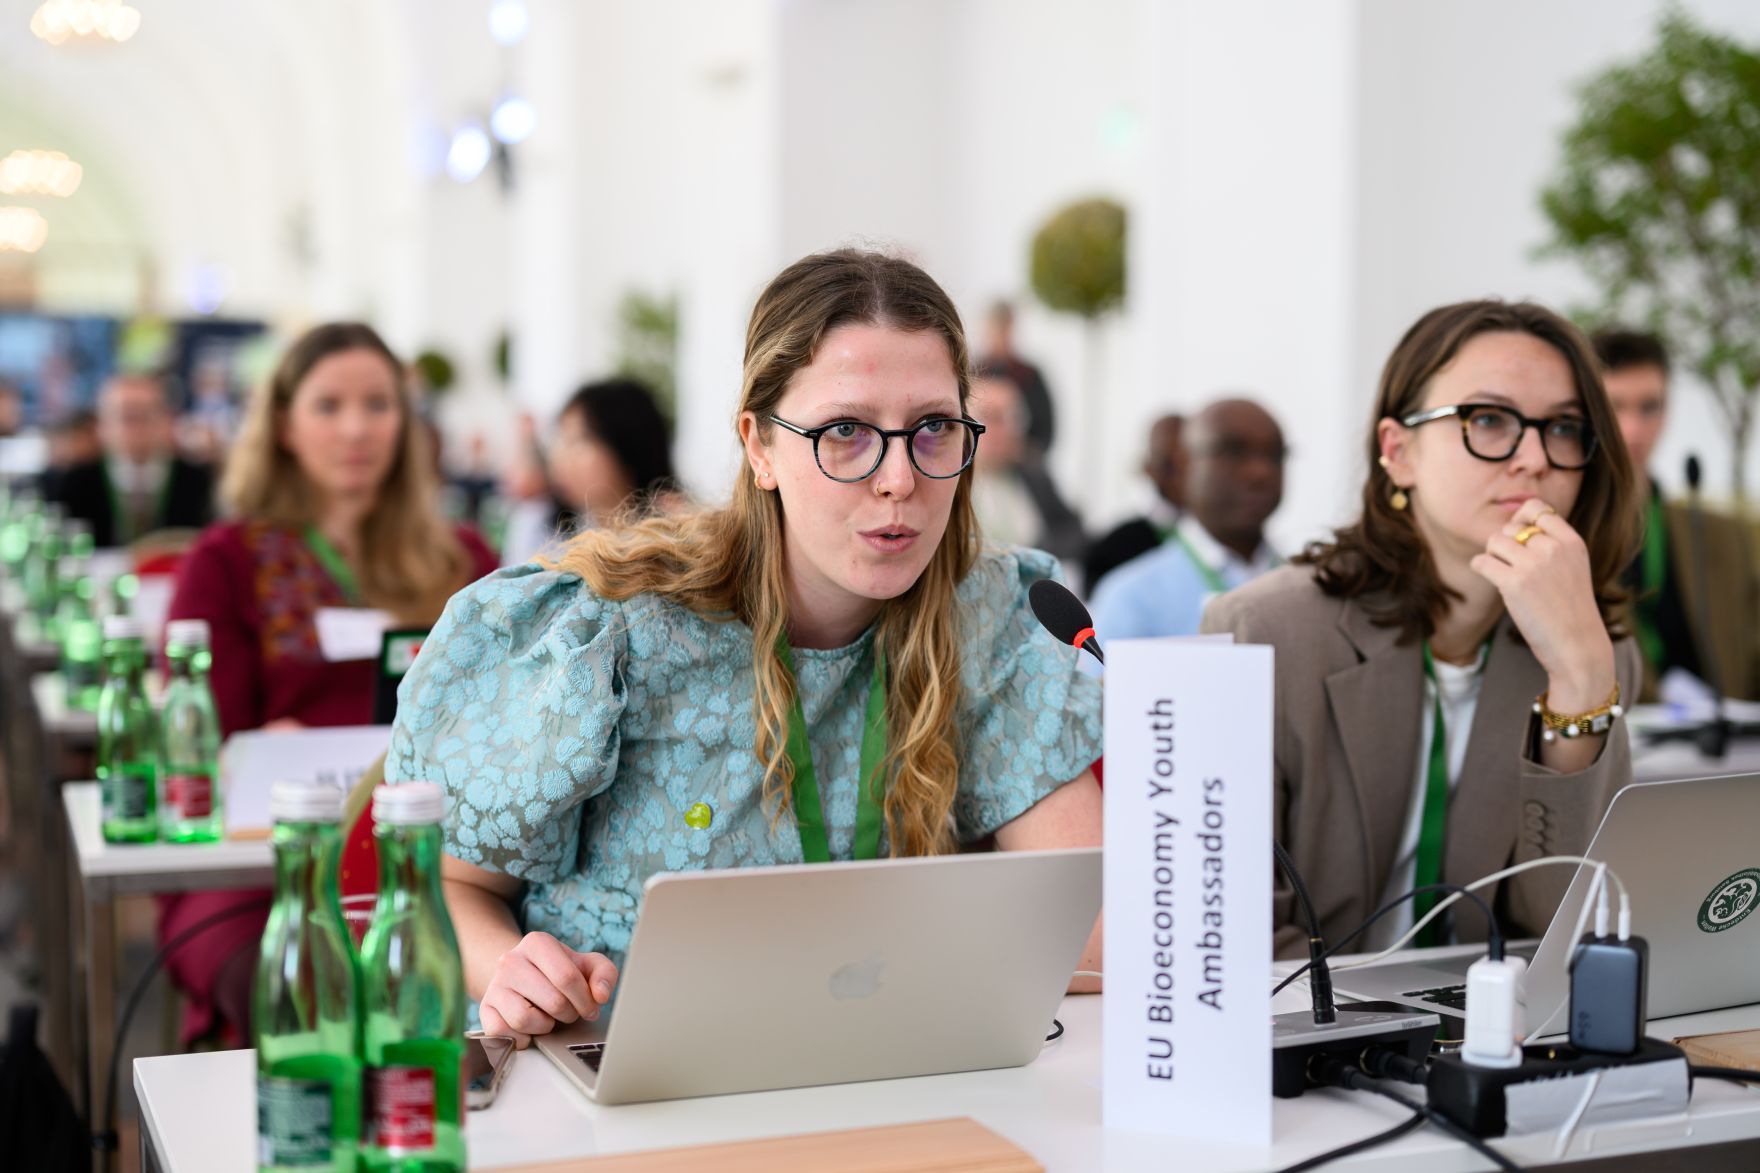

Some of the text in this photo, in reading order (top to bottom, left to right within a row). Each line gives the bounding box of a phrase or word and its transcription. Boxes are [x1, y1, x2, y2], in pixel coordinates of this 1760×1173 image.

[1146, 698, 1180, 1081] EU Bioeconomy Youth
[1195, 777, 1224, 1011] Ambassadors
